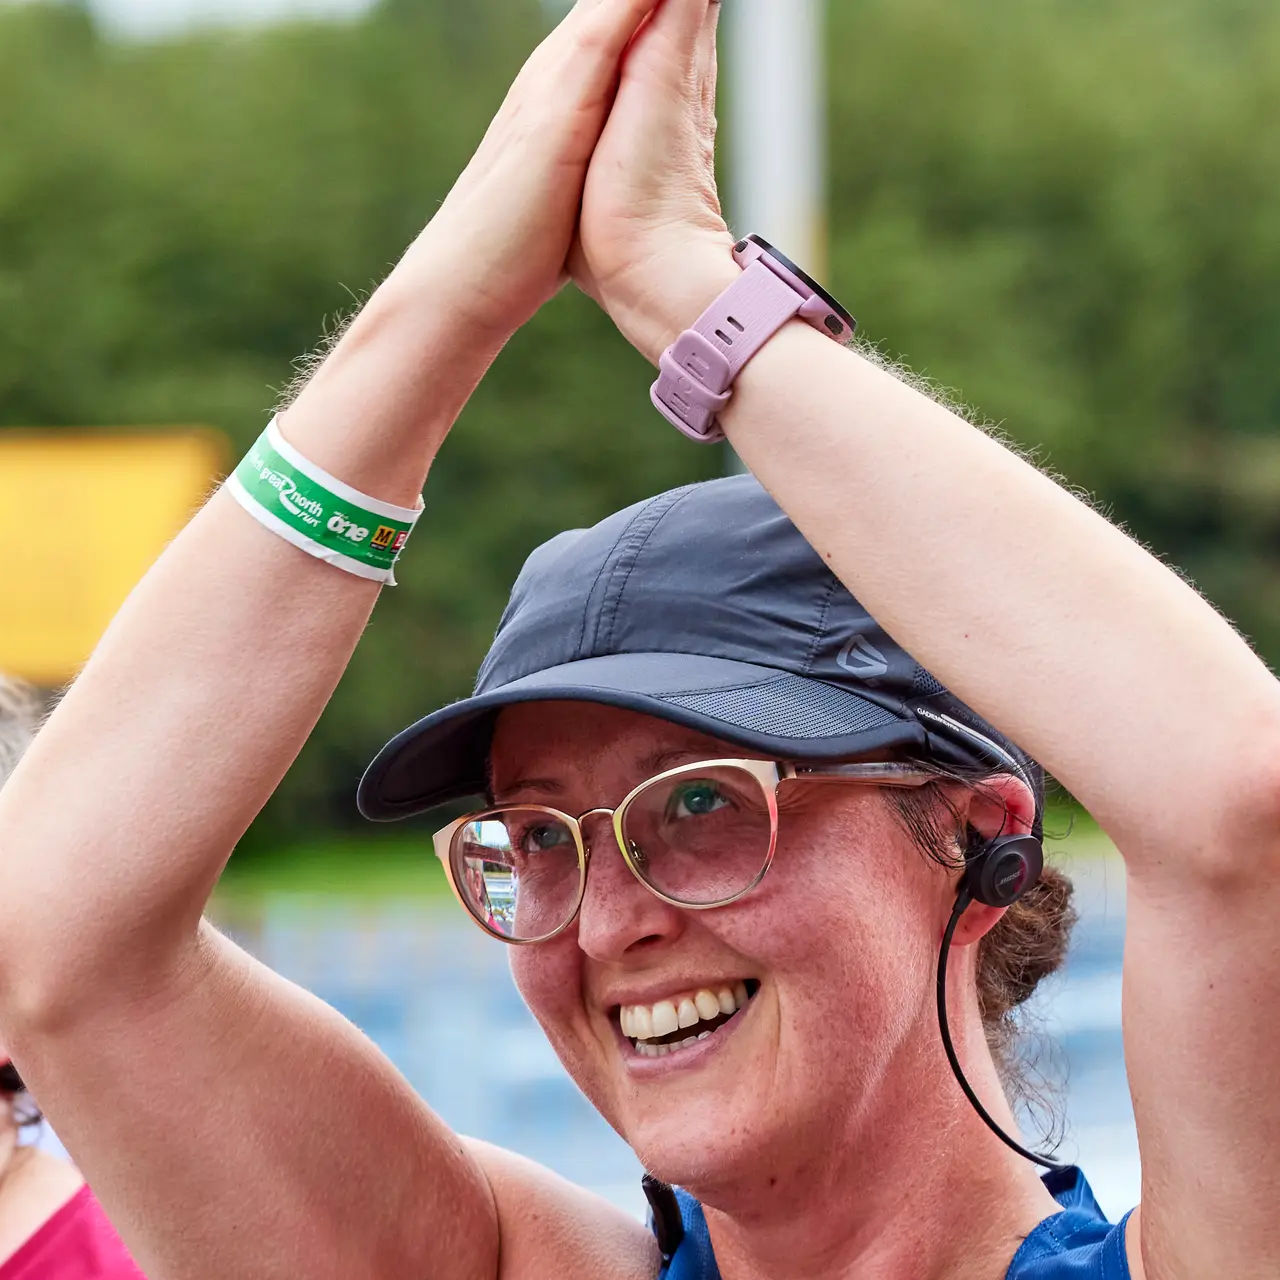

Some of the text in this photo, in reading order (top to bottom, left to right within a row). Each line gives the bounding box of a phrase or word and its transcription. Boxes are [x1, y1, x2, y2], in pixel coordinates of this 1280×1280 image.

[260, 468, 323, 517] great north
[297, 510, 321, 527] run
[327, 516, 369, 542] one
